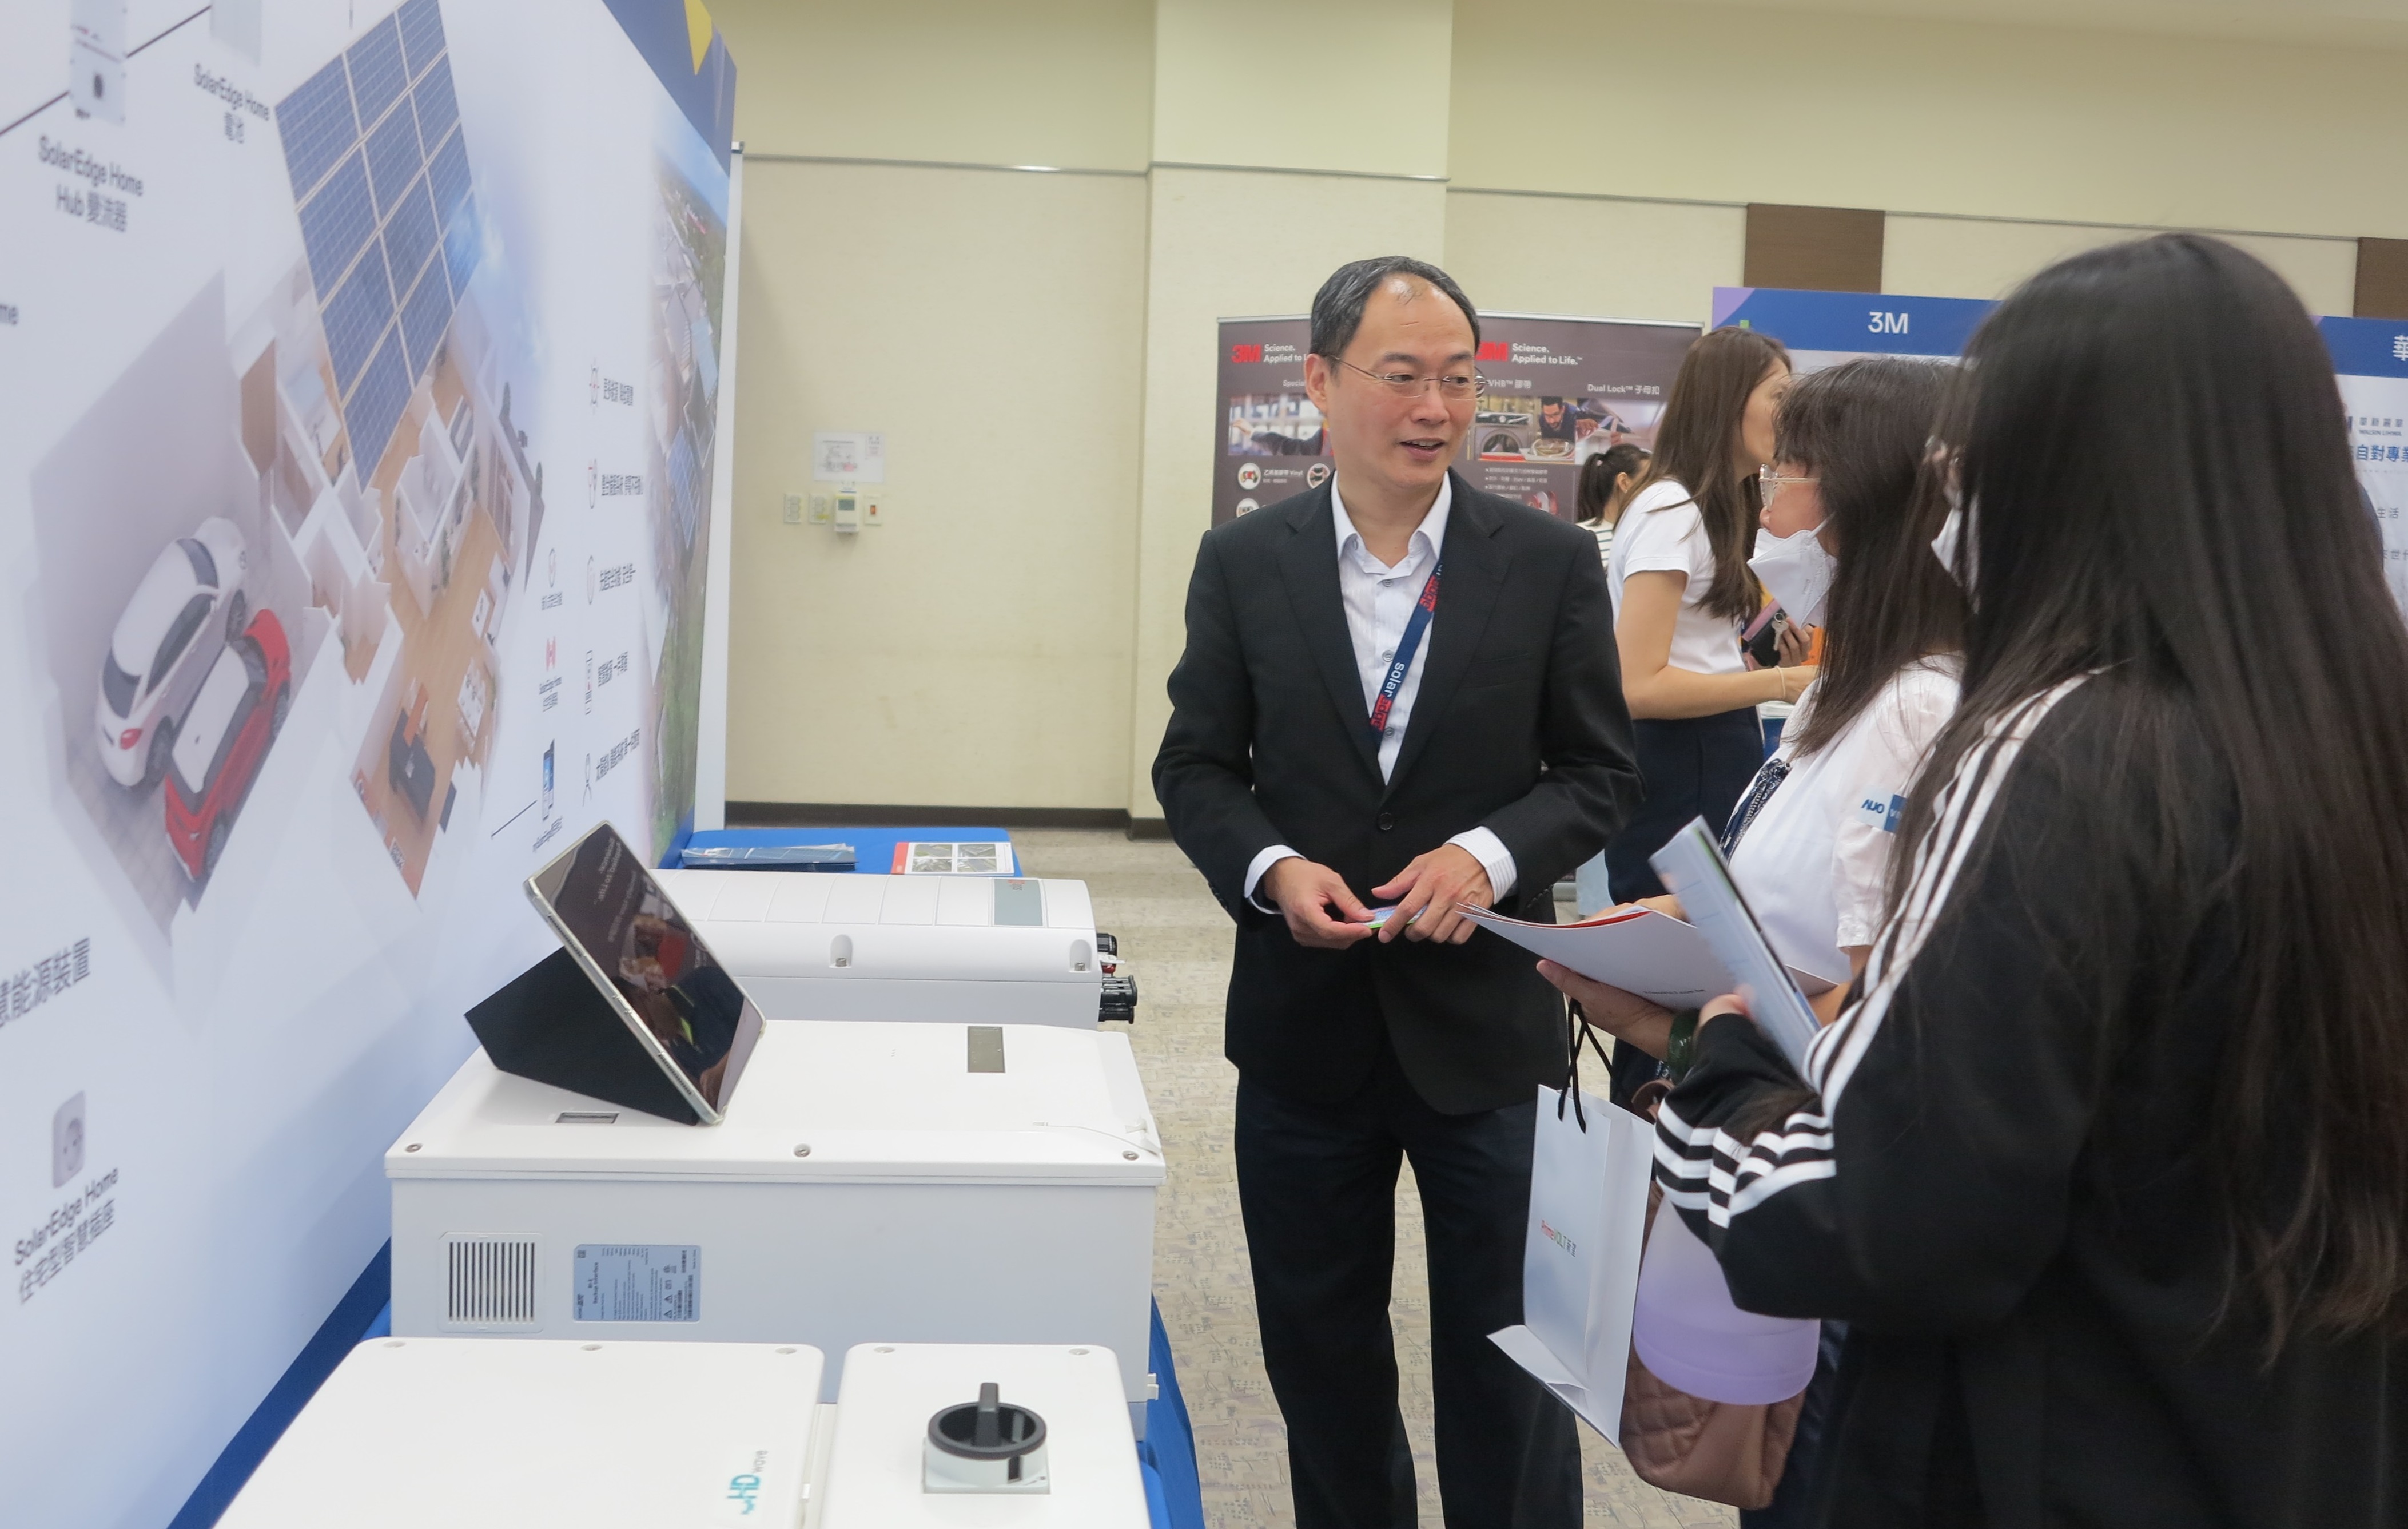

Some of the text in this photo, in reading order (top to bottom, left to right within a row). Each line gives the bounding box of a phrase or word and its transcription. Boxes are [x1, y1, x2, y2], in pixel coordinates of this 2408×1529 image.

[194, 63, 269, 121] SolarEdge Home
[39, 134, 144, 197] SolarEdge Home
[56, 184, 85, 216] Hub
[1867, 311, 1909, 334] 3M
[1231, 344, 1261, 363] 3M
[1263, 354, 1293, 363] Applied
[1264, 344, 1295, 352] Science.
[1511, 354, 1546, 364] Applied
[1549, 356, 1558, 364] to
[1512, 343, 1550, 353] Science.
[15, 1167, 118, 1266] SolarEdge Home
[726, 1474, 761, 1499] HD
